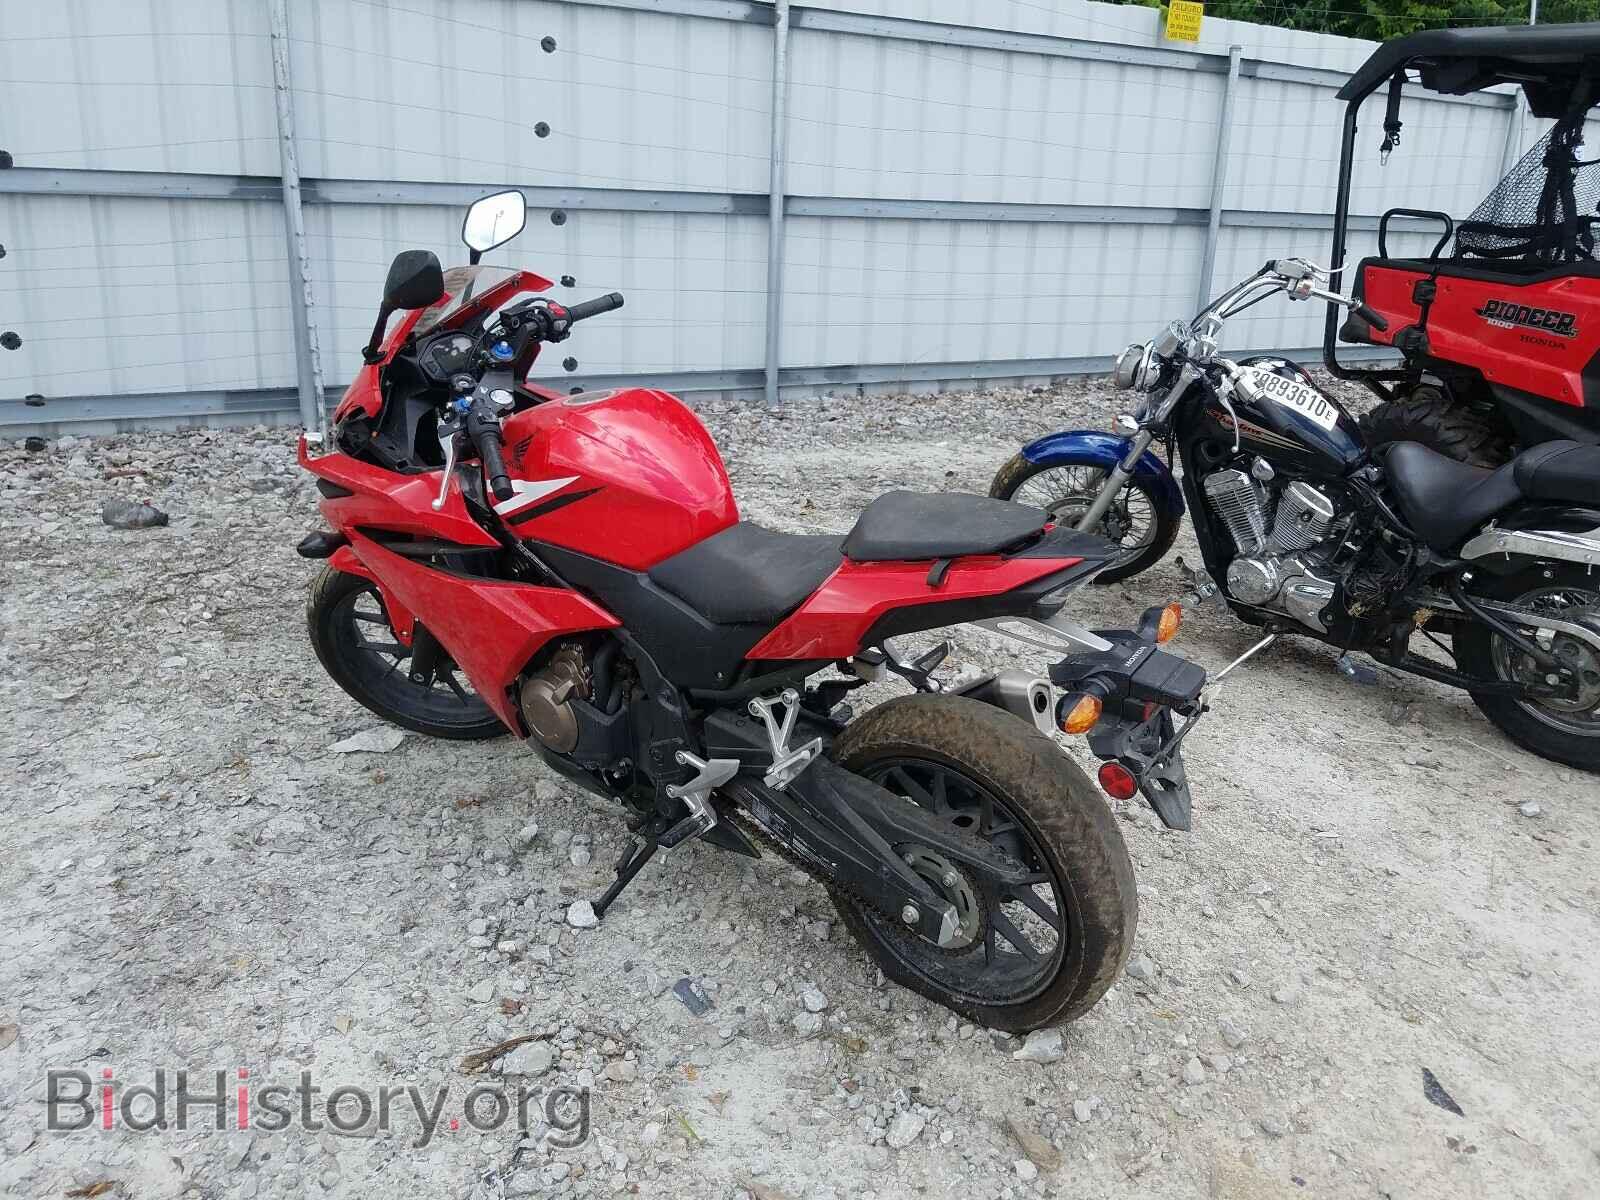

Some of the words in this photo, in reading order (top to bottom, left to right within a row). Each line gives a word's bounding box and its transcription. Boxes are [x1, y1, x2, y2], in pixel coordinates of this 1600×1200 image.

[1482, 299, 1576, 336] PIONEER
[1487, 318, 1514, 329] 1000
[1520, 334, 1567, 349] HONDA
